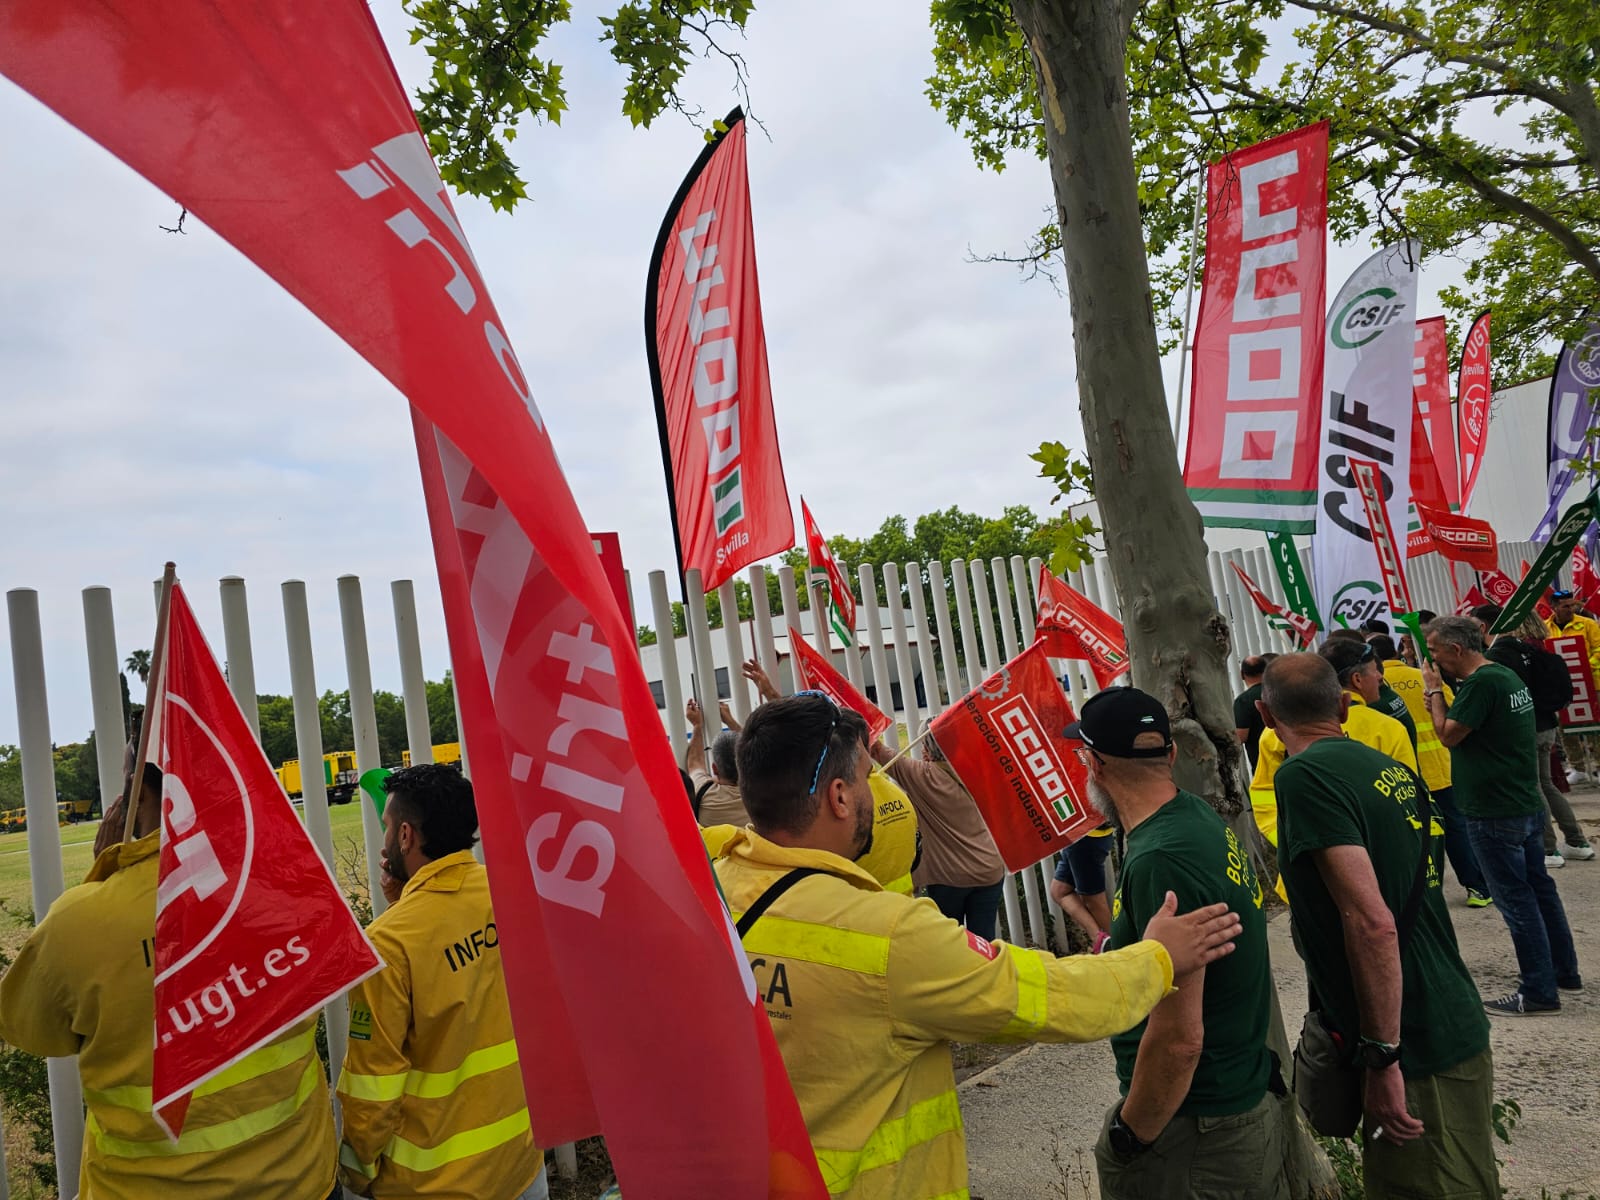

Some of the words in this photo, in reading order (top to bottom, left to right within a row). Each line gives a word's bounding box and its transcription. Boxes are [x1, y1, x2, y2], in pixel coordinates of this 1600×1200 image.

[1219, 149, 1301, 481] CCOO
[1345, 303, 1405, 331] CSIF
[1466, 319, 1489, 359] UGT
[1323, 390, 1396, 543] CSIF
[716, 531, 750, 565] Svilla
[1407, 534, 1431, 548] villa
[1333, 597, 1389, 622] CSIF
[1000, 706, 1066, 800] CCOO
[879, 799, 905, 817] INFOCA
[999, 754, 1015, 775] de
[1010, 775, 1053, 843] industria
